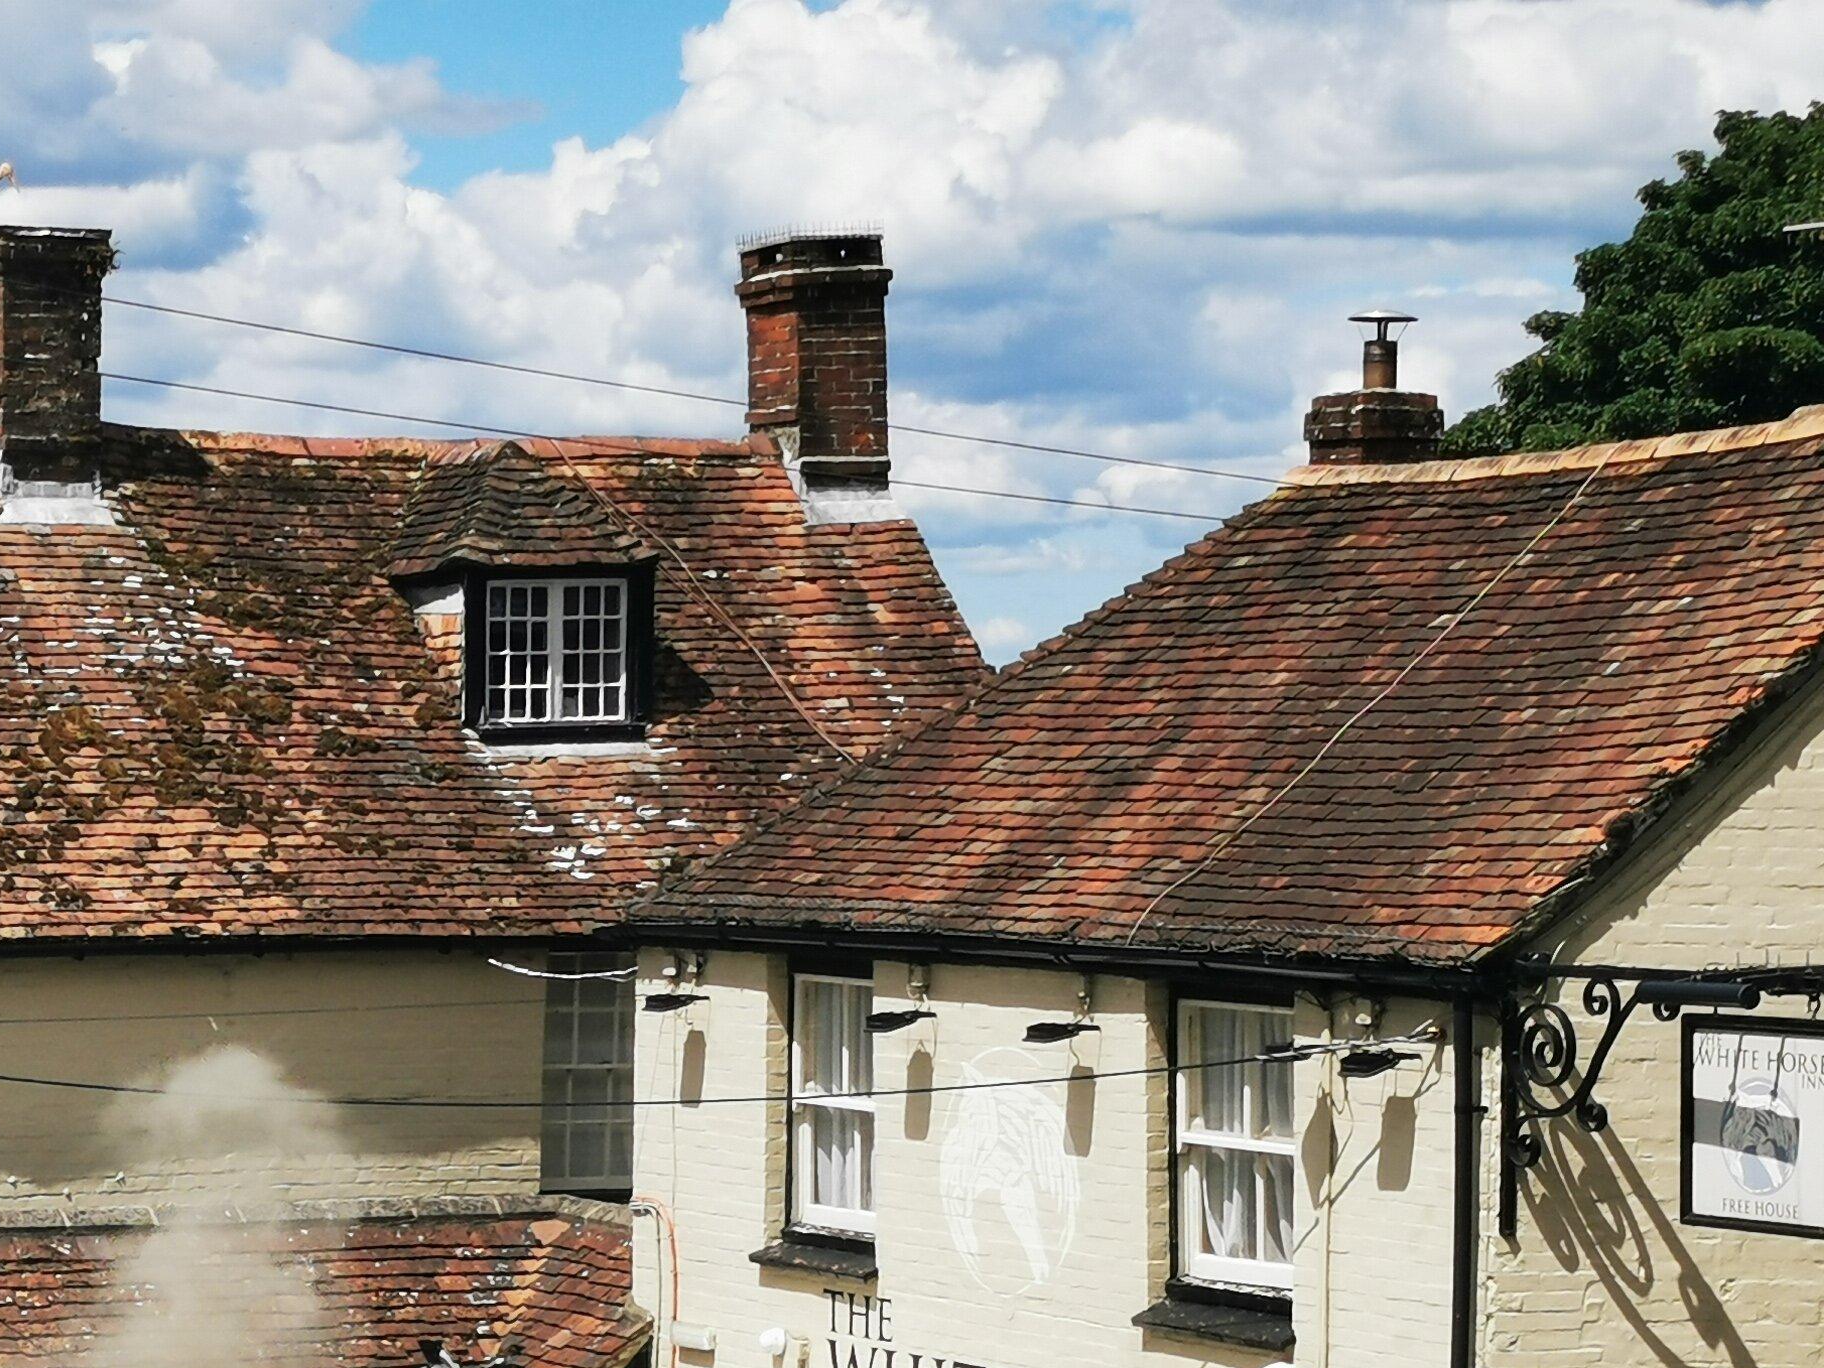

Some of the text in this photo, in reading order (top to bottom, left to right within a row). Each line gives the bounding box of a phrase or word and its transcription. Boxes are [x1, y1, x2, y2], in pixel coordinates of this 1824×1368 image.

[1696, 1047, 1760, 1070] WHITE
[1722, 1198, 1799, 1219] FREE HOUSE
[823, 1288, 893, 1342] THE
